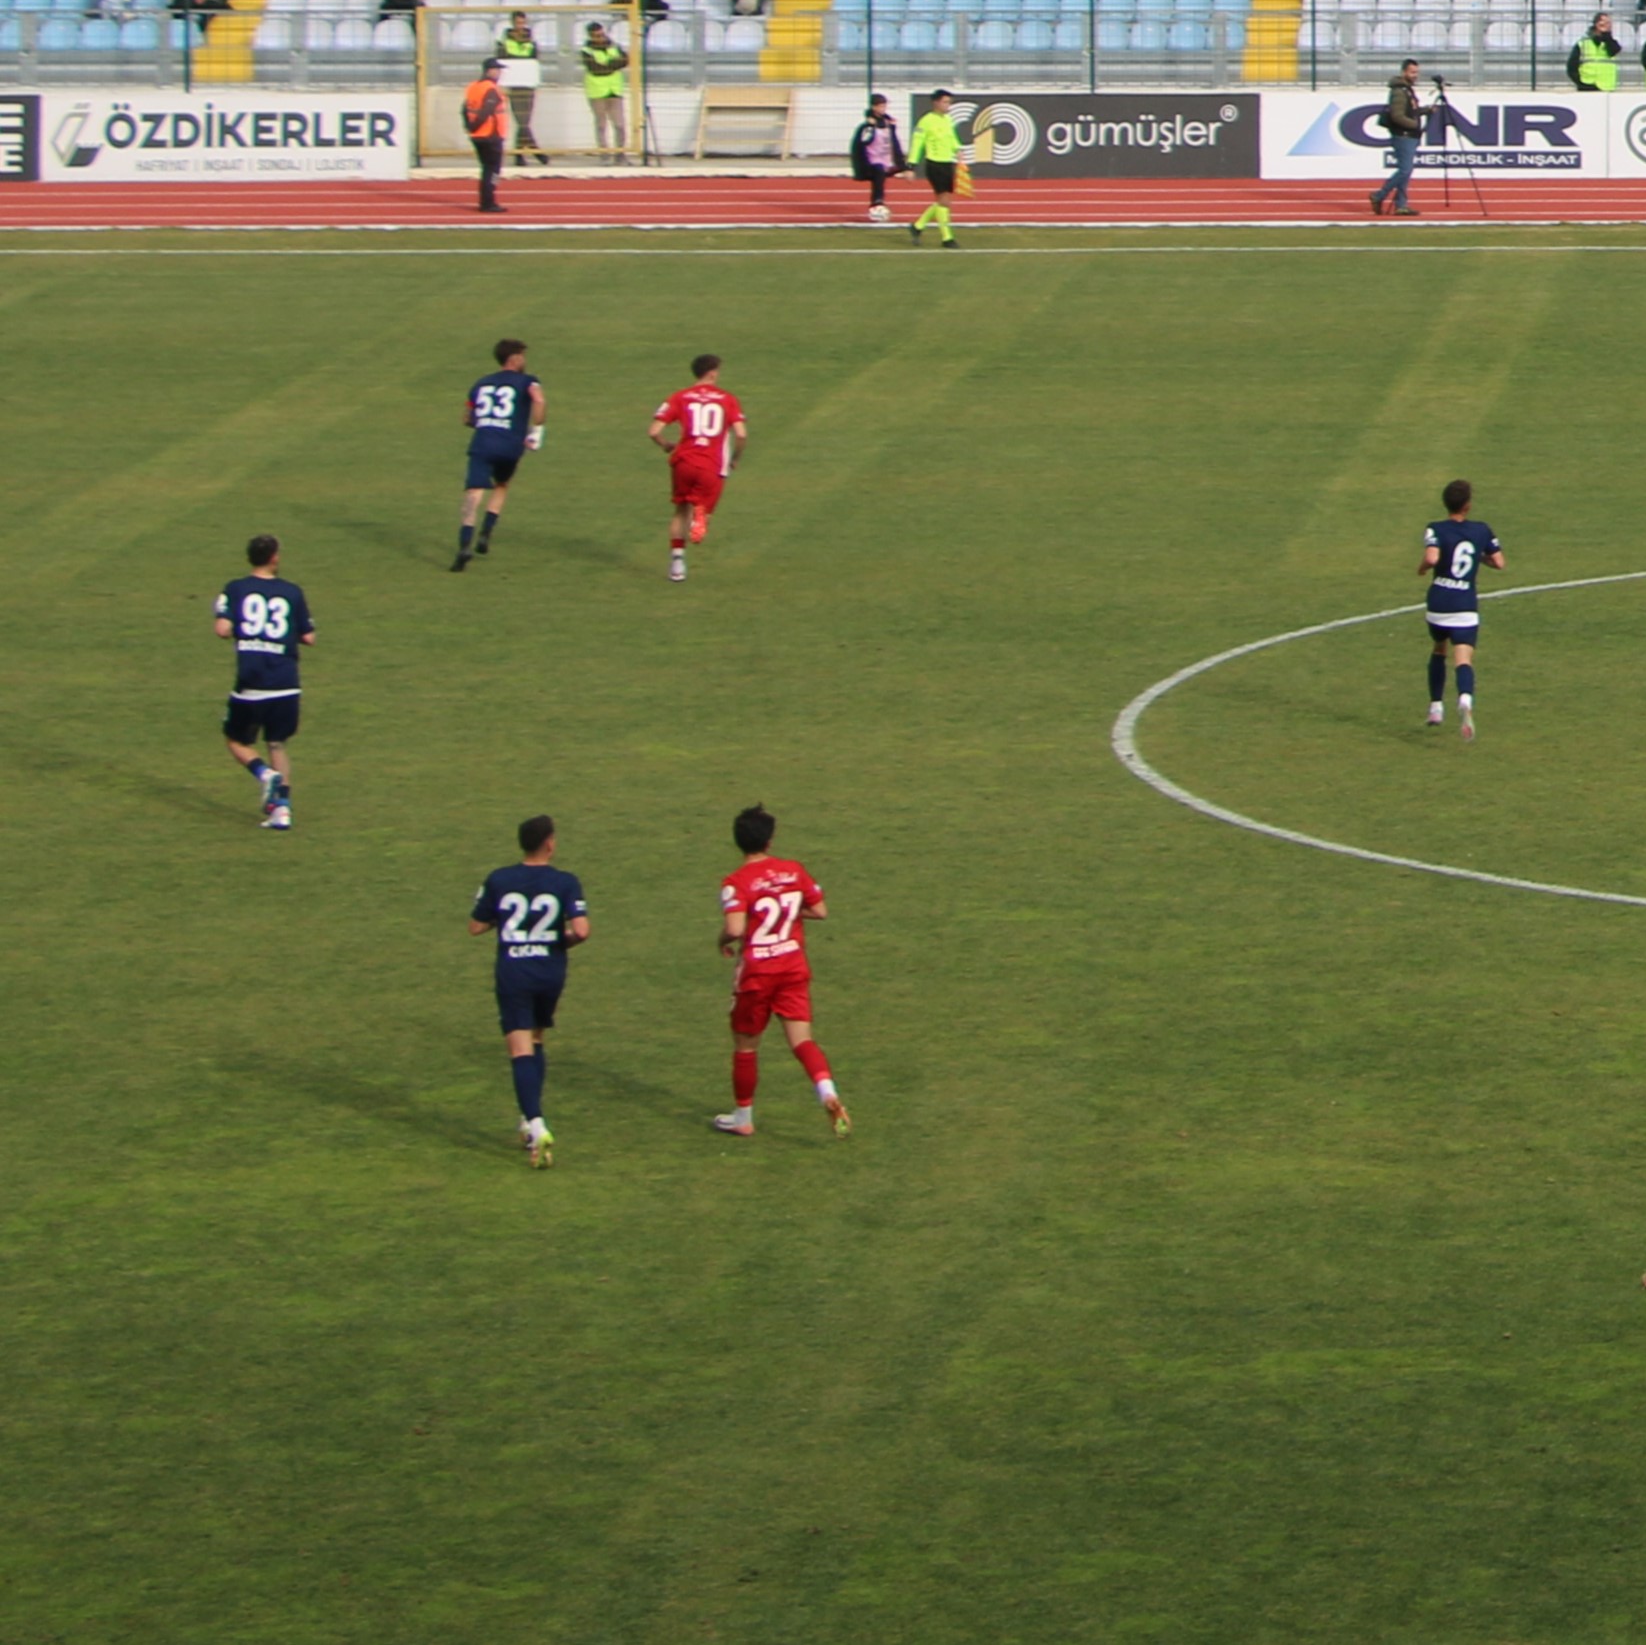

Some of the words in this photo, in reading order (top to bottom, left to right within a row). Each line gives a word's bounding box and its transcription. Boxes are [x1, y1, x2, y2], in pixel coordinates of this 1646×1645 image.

[104, 103, 397, 148] ÖZDİKERLER
[1046, 114, 1222, 155] gümüşler
[1386, 153, 1503, 166] MHENDİSLİK
[1517, 153, 1578, 167] İNŞAAT
[475, 385, 516, 418] 53
[688, 402, 725, 437] 10
[1450, 540, 1476, 579] 6
[240, 593, 290, 639] 93
[499, 891, 560, 943] 22
[750, 890, 803, 943] 27
